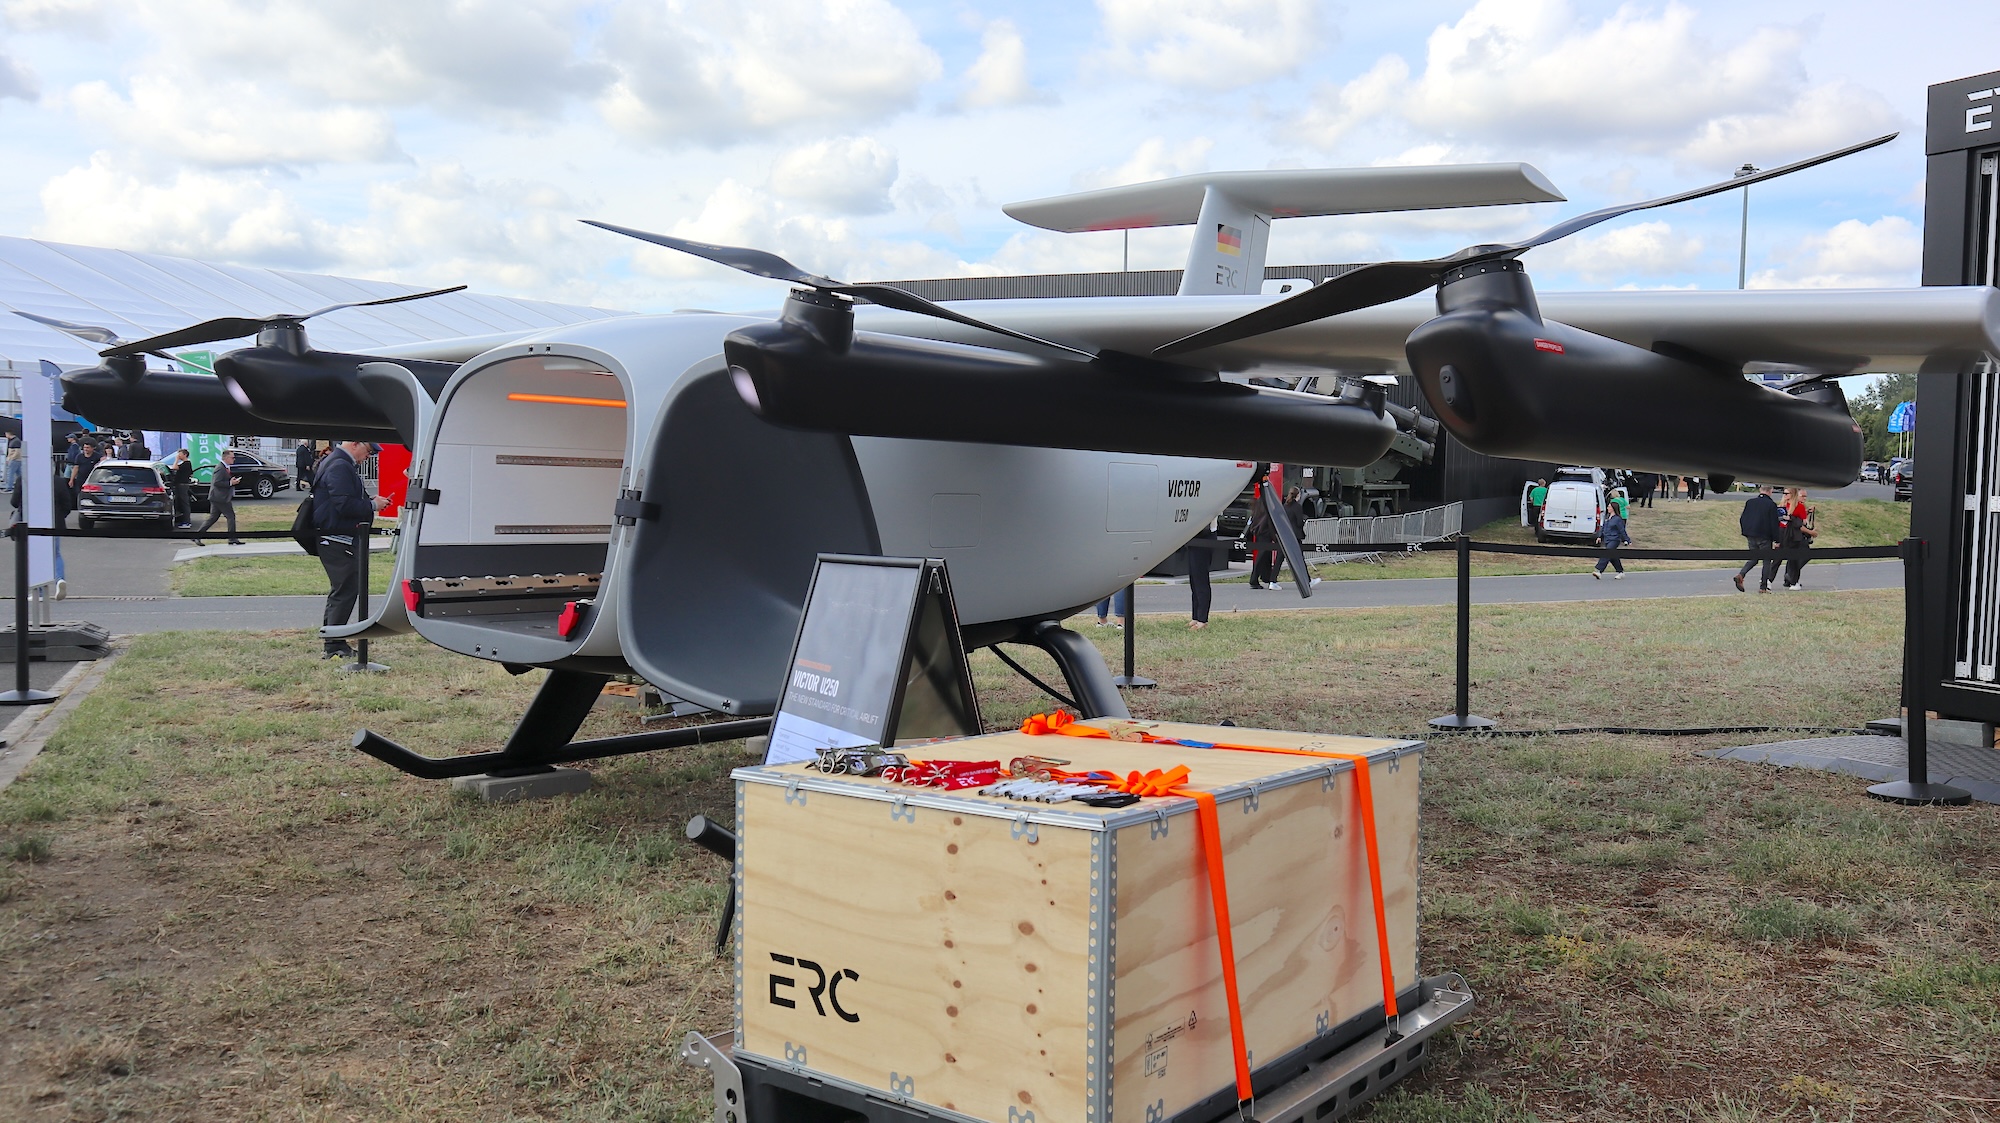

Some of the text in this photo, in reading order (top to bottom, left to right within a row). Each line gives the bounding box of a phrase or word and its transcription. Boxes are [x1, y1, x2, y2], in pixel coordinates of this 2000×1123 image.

[1965, 87, 2000, 133] E
[1216, 265, 1238, 288] ERC
[1168, 479, 1201, 498] VICTOR
[1234, 541, 1247, 549] ERC
[1315, 544, 1330, 552] ERC
[1406, 542, 1422, 551] ERC
[793, 669, 840, 698] VICTOR U250
[788, 691, 799, 703] THE
[797, 694, 810, 705] NEW
[808, 696, 832, 712] STANDARD
[831, 702, 841, 715] FOR
[859, 711, 880, 726] AIRLIFT
[956, 776, 980, 786] ERC
[769, 952, 860, 1023] ERC
